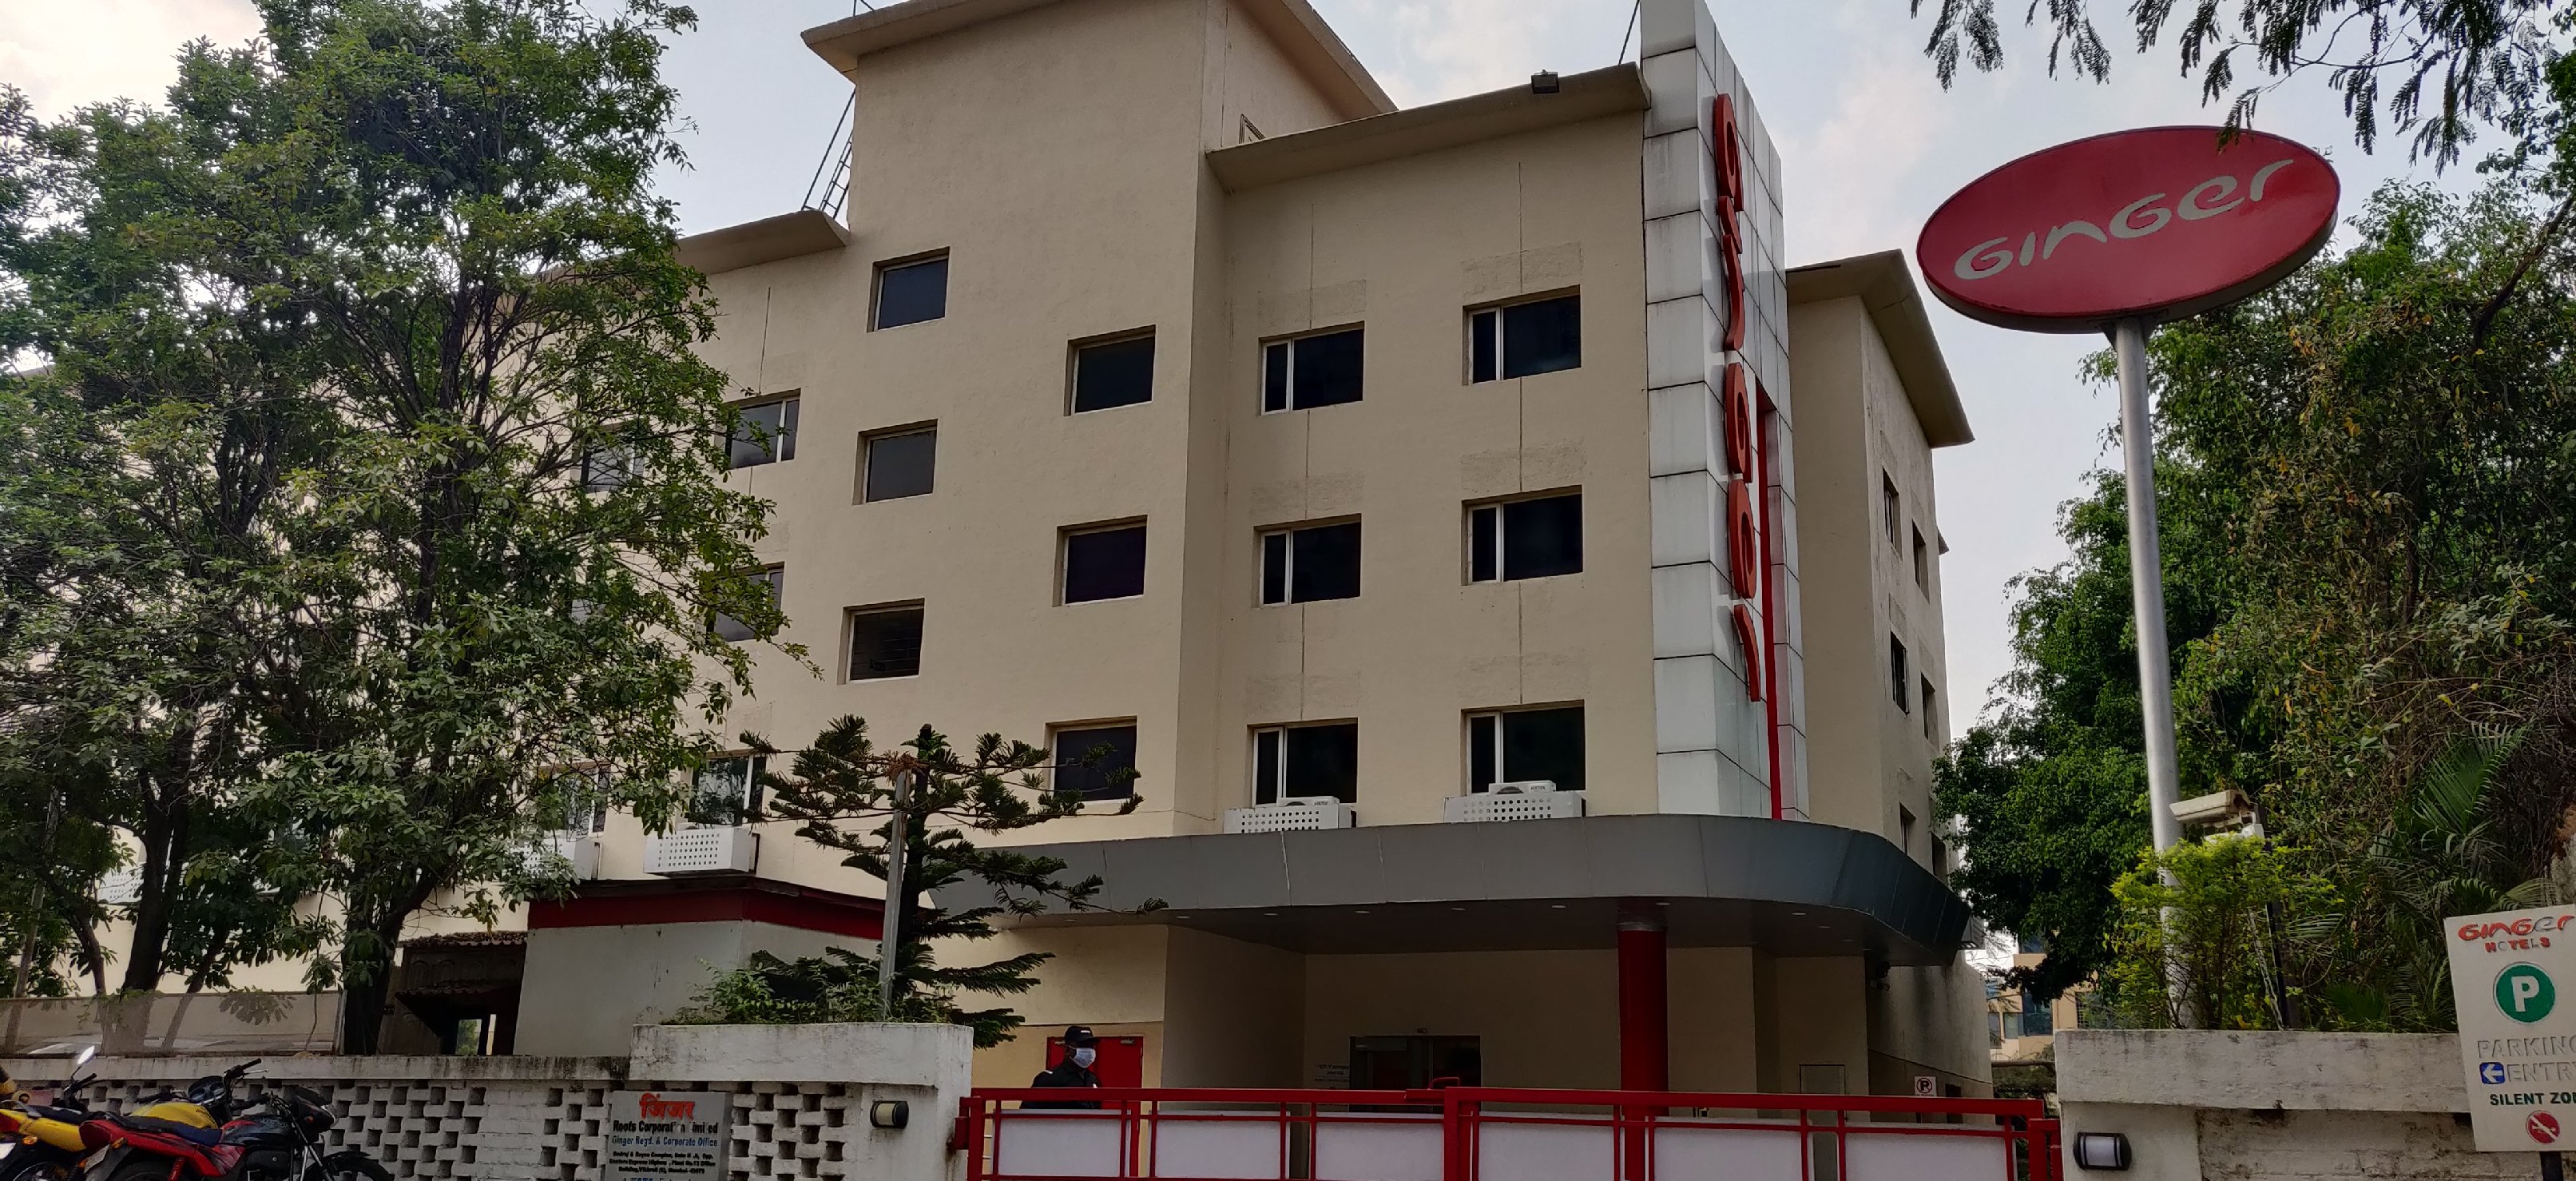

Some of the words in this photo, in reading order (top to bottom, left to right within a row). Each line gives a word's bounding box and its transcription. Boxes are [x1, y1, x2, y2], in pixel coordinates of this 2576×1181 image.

[2485, 936, 2550, 952] HOTELS
[2511, 975, 2540, 1012] P
[2490, 1093, 2545, 1105] SILENT
[613, 1119, 637, 1132] Roots
[639, 1120, 685, 1135] Corporatn
[612, 1135, 633, 1146] Ginger
[636, 1135, 653, 1147] Regd.
[663, 1136, 695, 1147] Corporate
[697, 1137, 718, 1147] Office
